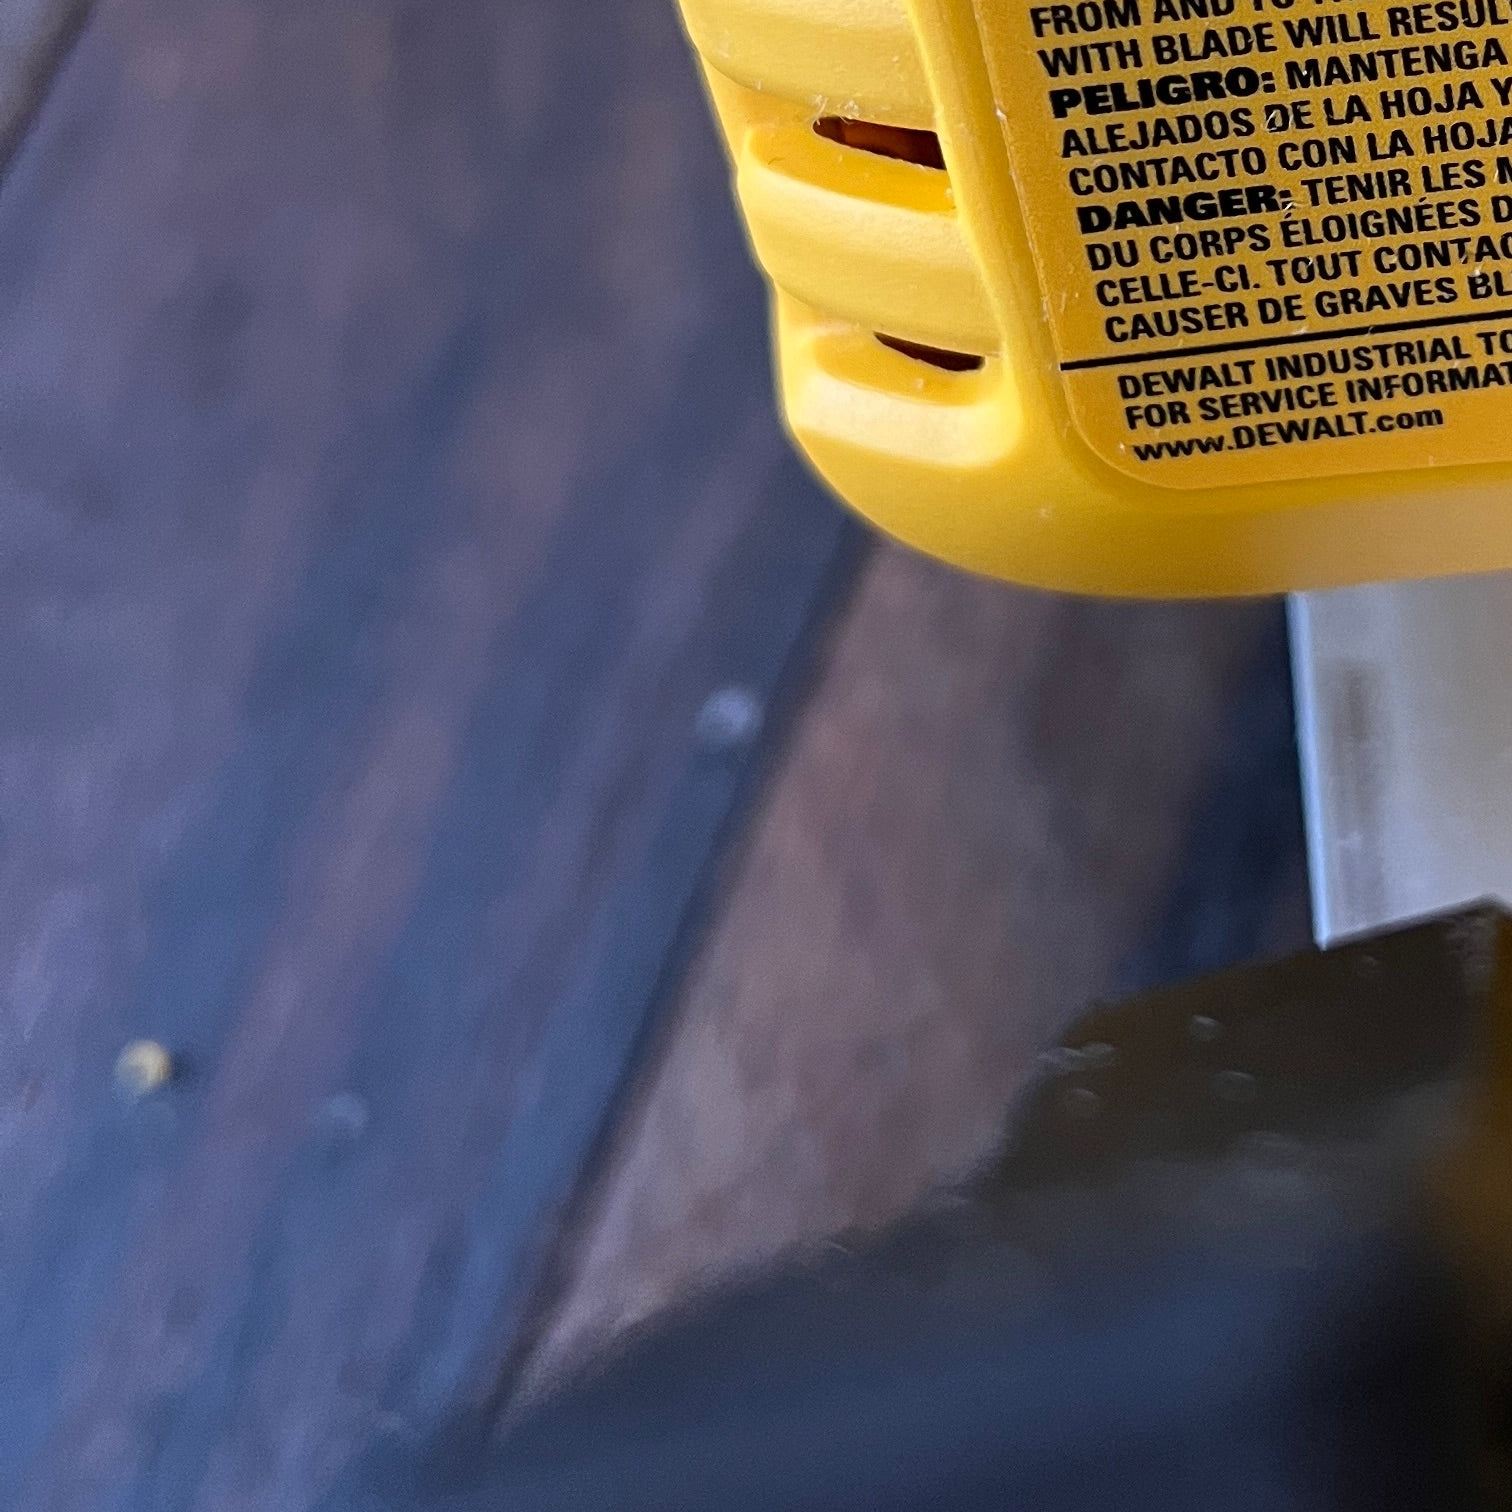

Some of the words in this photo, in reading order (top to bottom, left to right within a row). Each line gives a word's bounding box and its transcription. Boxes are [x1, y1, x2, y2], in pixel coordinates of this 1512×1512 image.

[1036, 38, 1144, 78] WITH
[1151, 21, 1278, 66] BLADE
[1282, 11, 1381, 49] WILL
[1048, 66, 1277, 119] PELIGRO:
[1284, 37, 1509, 90] MANTENGA
[1061, 107, 1256, 159] ALEJADOS
[1263, 99, 1315, 134] DE
[1322, 94, 1373, 127] LA
[1379, 80, 1485, 120] HOJA
[1068, 146, 1267, 196] CONTACTO
[1277, 135, 1358, 172] CON
[1366, 129, 1415, 162] LA
[1075, 184, 1292, 235] DANGER:
[1300, 168, 1413, 207] TENIR
[1421, 159, 1486, 194] LES
[1084, 239, 1140, 272] DU
[1149, 223, 1271, 264] CORPS
[1279, 196, 1482, 248] ÉLOIGNÉES
[1095, 263, 1261, 308] CELLE-CI.
[1265, 249, 1363, 287] TOUT
[1104, 301, 1249, 343] CAUSER
[1257, 293, 1307, 325] DE
[1314, 276, 1459, 318] GRAVES
[1117, 359, 1256, 400] DEWALT
[1264, 335, 1473, 382] INDUSTRIAL
[1124, 400, 1192, 431] FOR
[1197, 382, 1339, 422] SERVICE
[1132, 408, 1444, 462] www.DEWALT.com
